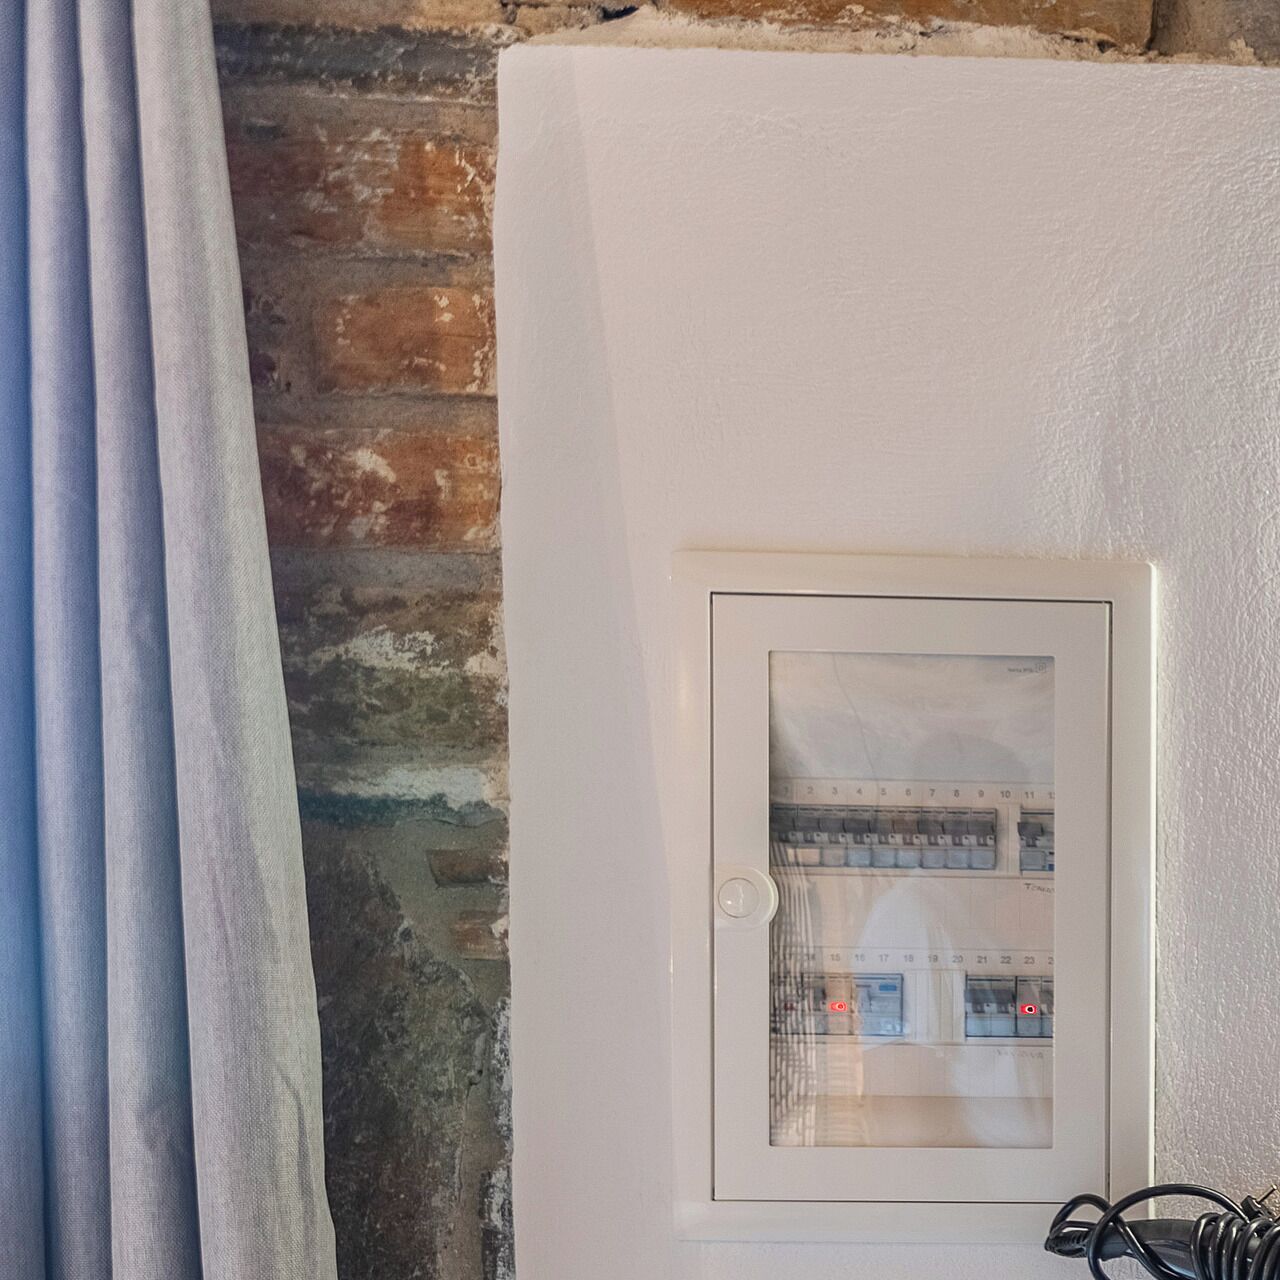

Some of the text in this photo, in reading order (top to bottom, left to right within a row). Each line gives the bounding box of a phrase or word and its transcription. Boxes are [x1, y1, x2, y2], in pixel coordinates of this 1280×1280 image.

[1000, 790, 1011, 798] 10
[1024, 791, 1035, 799] 11
[830, 953, 841, 962] 15
[878, 953, 889, 962] 17
[903, 954, 914, 962] 18
[928, 954, 938, 962] 19
[952, 955, 963, 963] 20
[977, 955, 987, 964] 21
[1000, 956, 1012, 964] 22
[1024, 956, 1035, 964] 23
